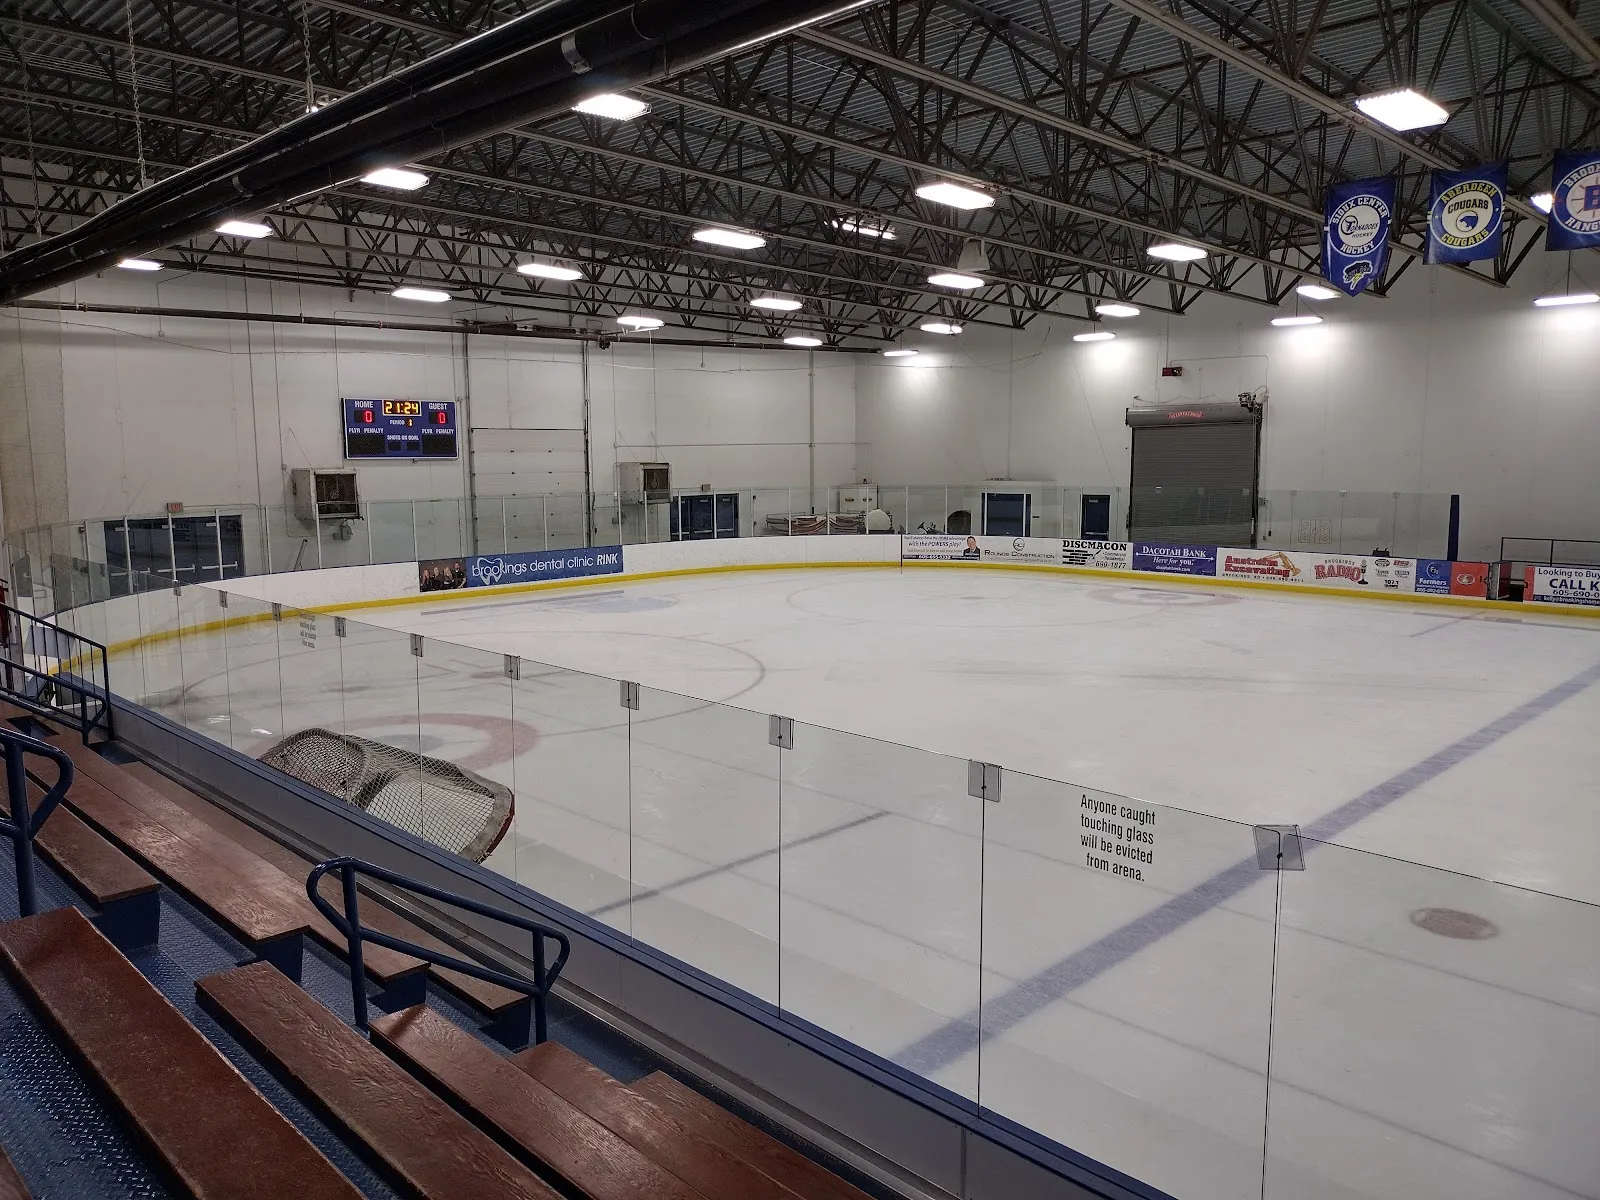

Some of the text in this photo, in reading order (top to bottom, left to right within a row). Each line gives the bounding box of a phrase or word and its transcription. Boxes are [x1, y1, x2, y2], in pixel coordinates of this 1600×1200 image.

[1441, 183, 1497, 203] ABERDEEN
[1332, 197, 1388, 224] SIOUX CENTER
[1448, 199, 1489, 214] COUGARS
[1565, 217, 1600, 232] RANG
[1441, 229, 1489, 246] COUGARS
[1340, 241, 1375, 254] HOCKEY
[354, 400, 374, 409] HOME
[385, 402, 419, 414] 21:24
[429, 402, 448, 411] GUEST
[365, 411, 373, 423] 0
[438, 412, 446, 424] 0
[1062, 540, 1127, 552] DISCMACON
[1142, 546, 1206, 558] DACOTAH BANK
[472, 553, 619, 577] brookings dental clinic RINK
[1168, 557, 1179, 565] for
[1224, 564, 1290, 577] Excavating
[1314, 565, 1361, 582] RADIO
[1538, 568, 1573, 579] Looking
[1575, 569, 1583, 578] to
[1419, 578, 1447, 587] Farmers
[1549, 579, 1586, 591] CALL
[1080, 794, 1156, 826] Anyone caught
[1080, 813, 1154, 845] touching glass
[1080, 834, 1153, 865] will be evicted
[1086, 852, 1145, 882] from arena.
